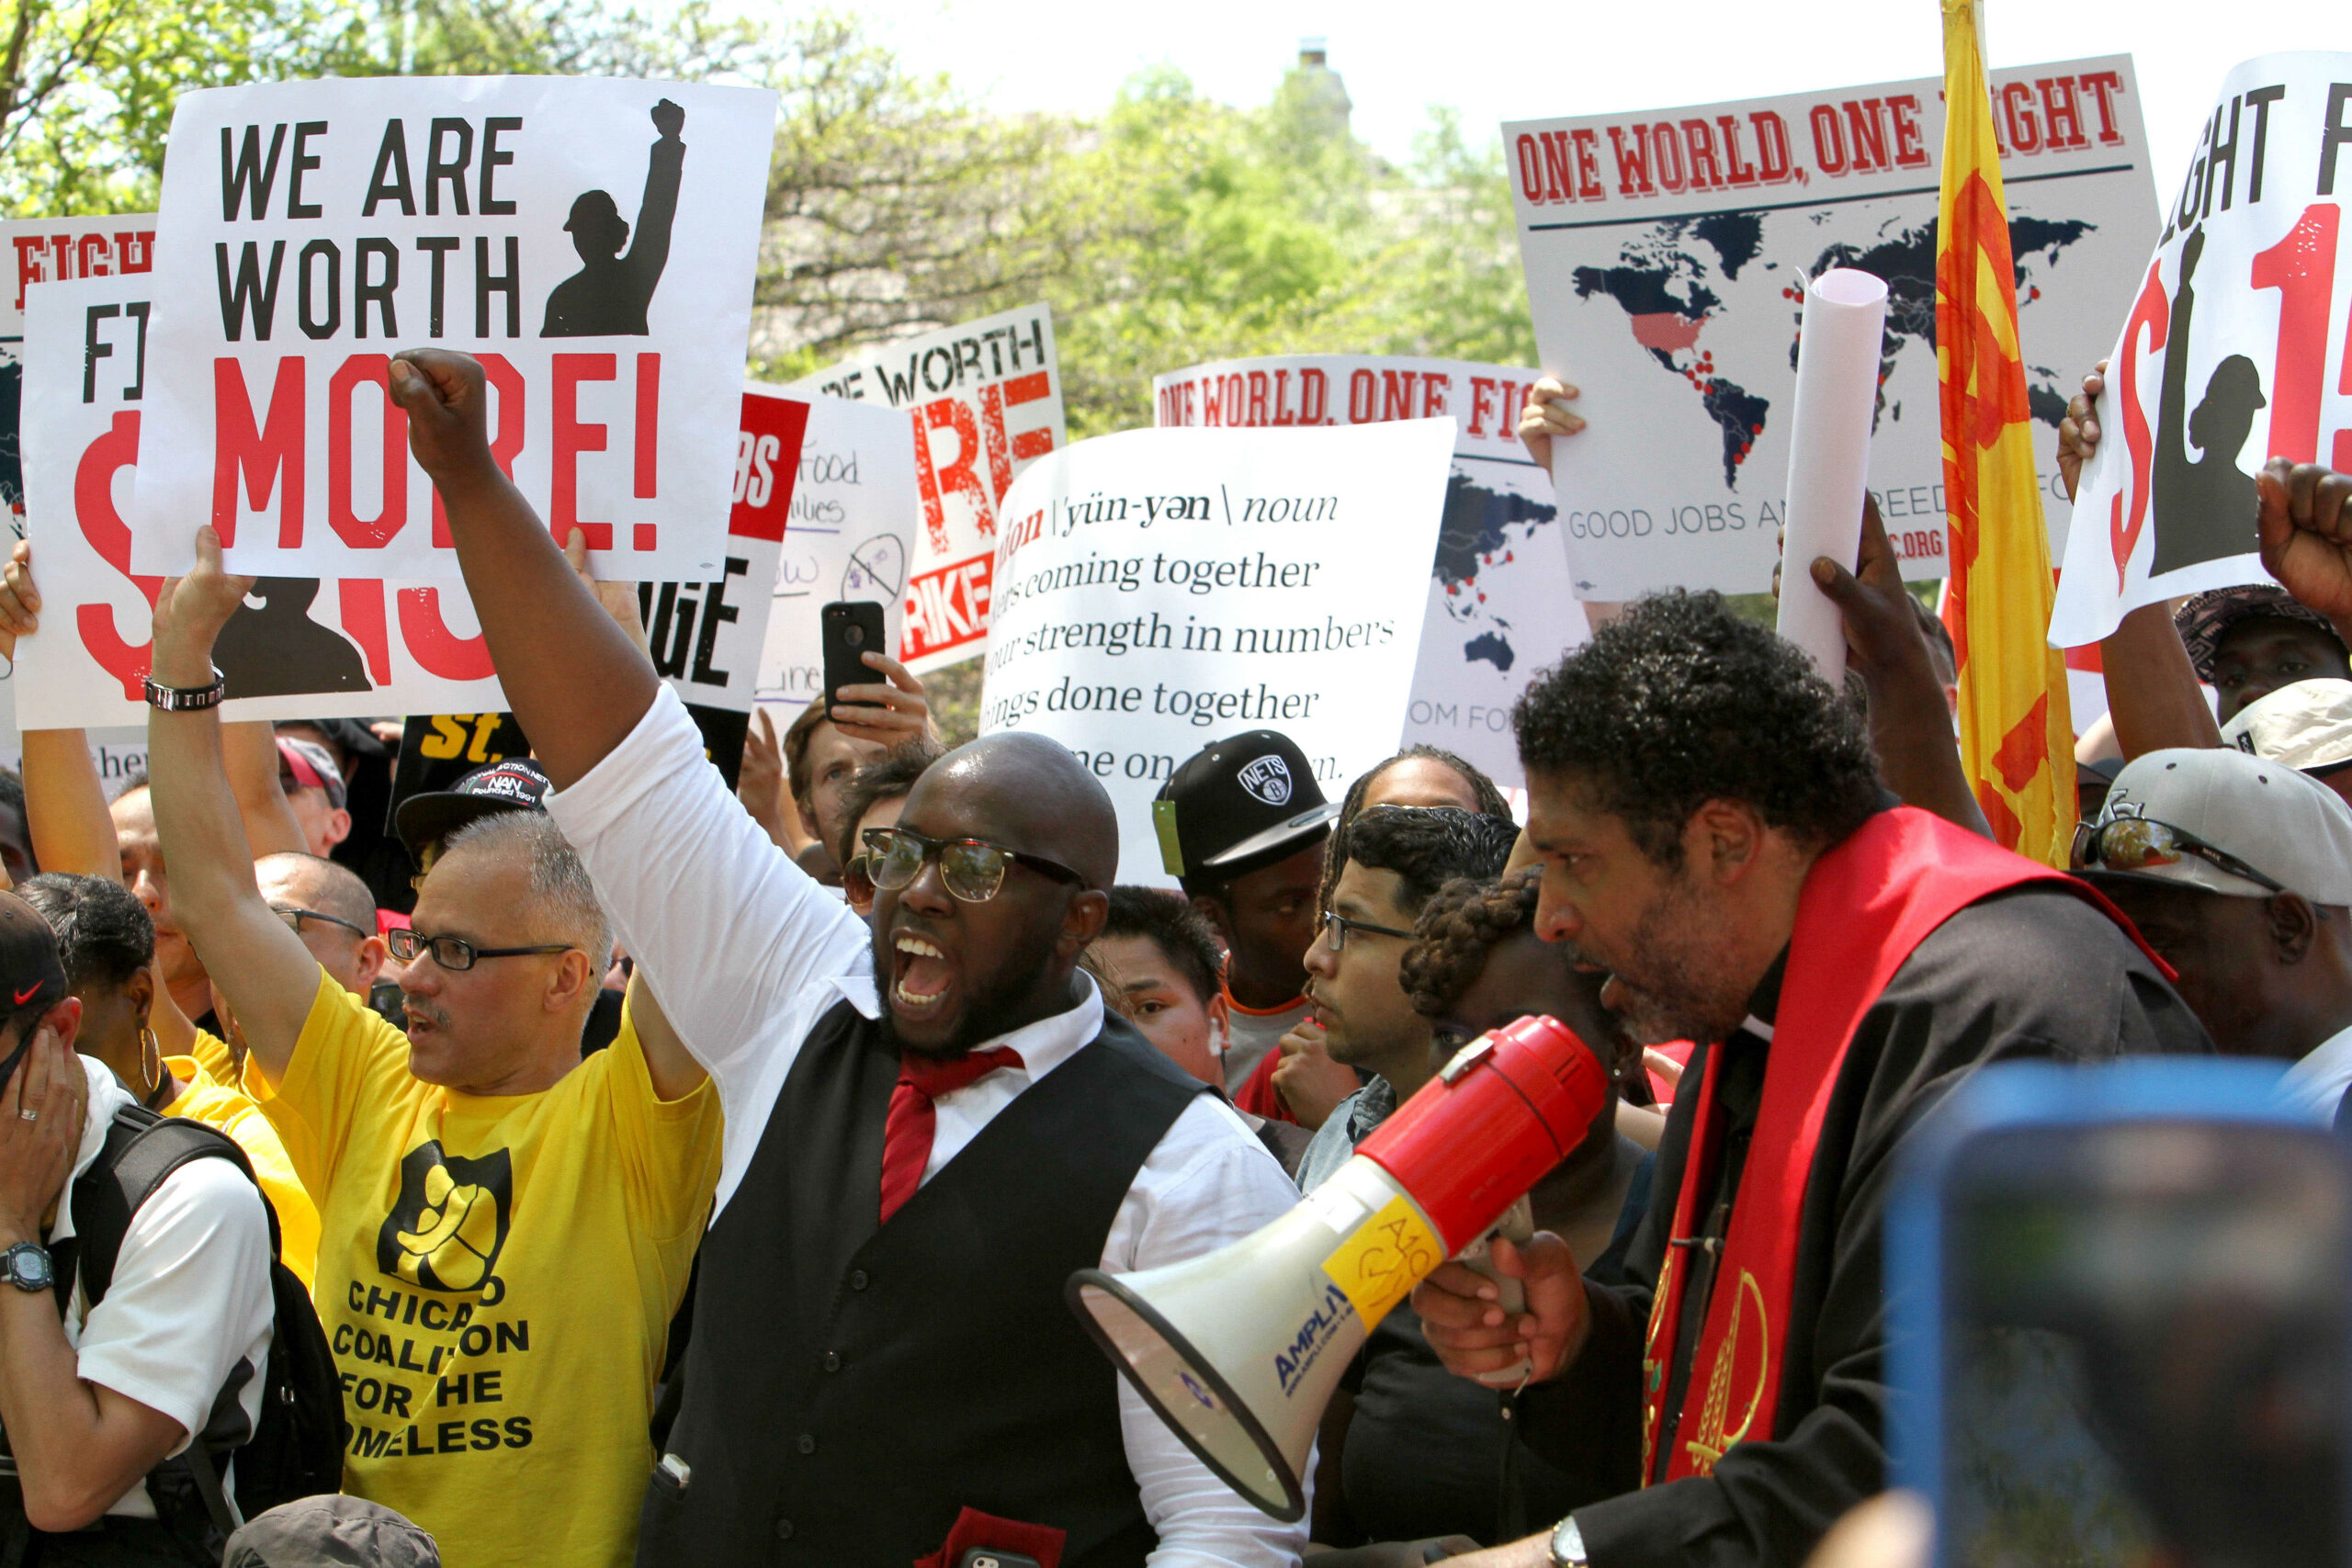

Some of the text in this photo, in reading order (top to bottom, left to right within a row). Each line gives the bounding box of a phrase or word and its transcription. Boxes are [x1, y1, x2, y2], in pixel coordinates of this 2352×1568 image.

[1516, 71, 2123, 206] ONE WORLD, ONE GHT
[220, 117, 524, 222] WE ARE
[2159, 84, 2285, 249] GHT
[215, 236, 520, 342] WORTH
[876, 319, 1046, 407] WORTH
[1159, 380, 1197, 427] ONE
[1349, 368, 1453, 424] ONE
[1243, 495, 1339, 523] noun
[1569, 509, 1653, 540] GOOD
[1664, 502, 1747, 536] JOBS
[1025, 551, 1145, 592] coming
[1153, 552, 1320, 594] together
[1023, 612, 1173, 657] strength
[1182, 615, 1223, 652] in
[1233, 615, 1395, 654] numbers
[1046, 676, 1143, 712] done
[1153, 682, 1320, 727] together
[487, 776, 524, 793] NAN
[496, 761, 531, 776] ACTION
[1242, 758, 1286, 791] NETS
[1269, 781, 1281, 798] B
[515, 791, 537, 804] 1991
